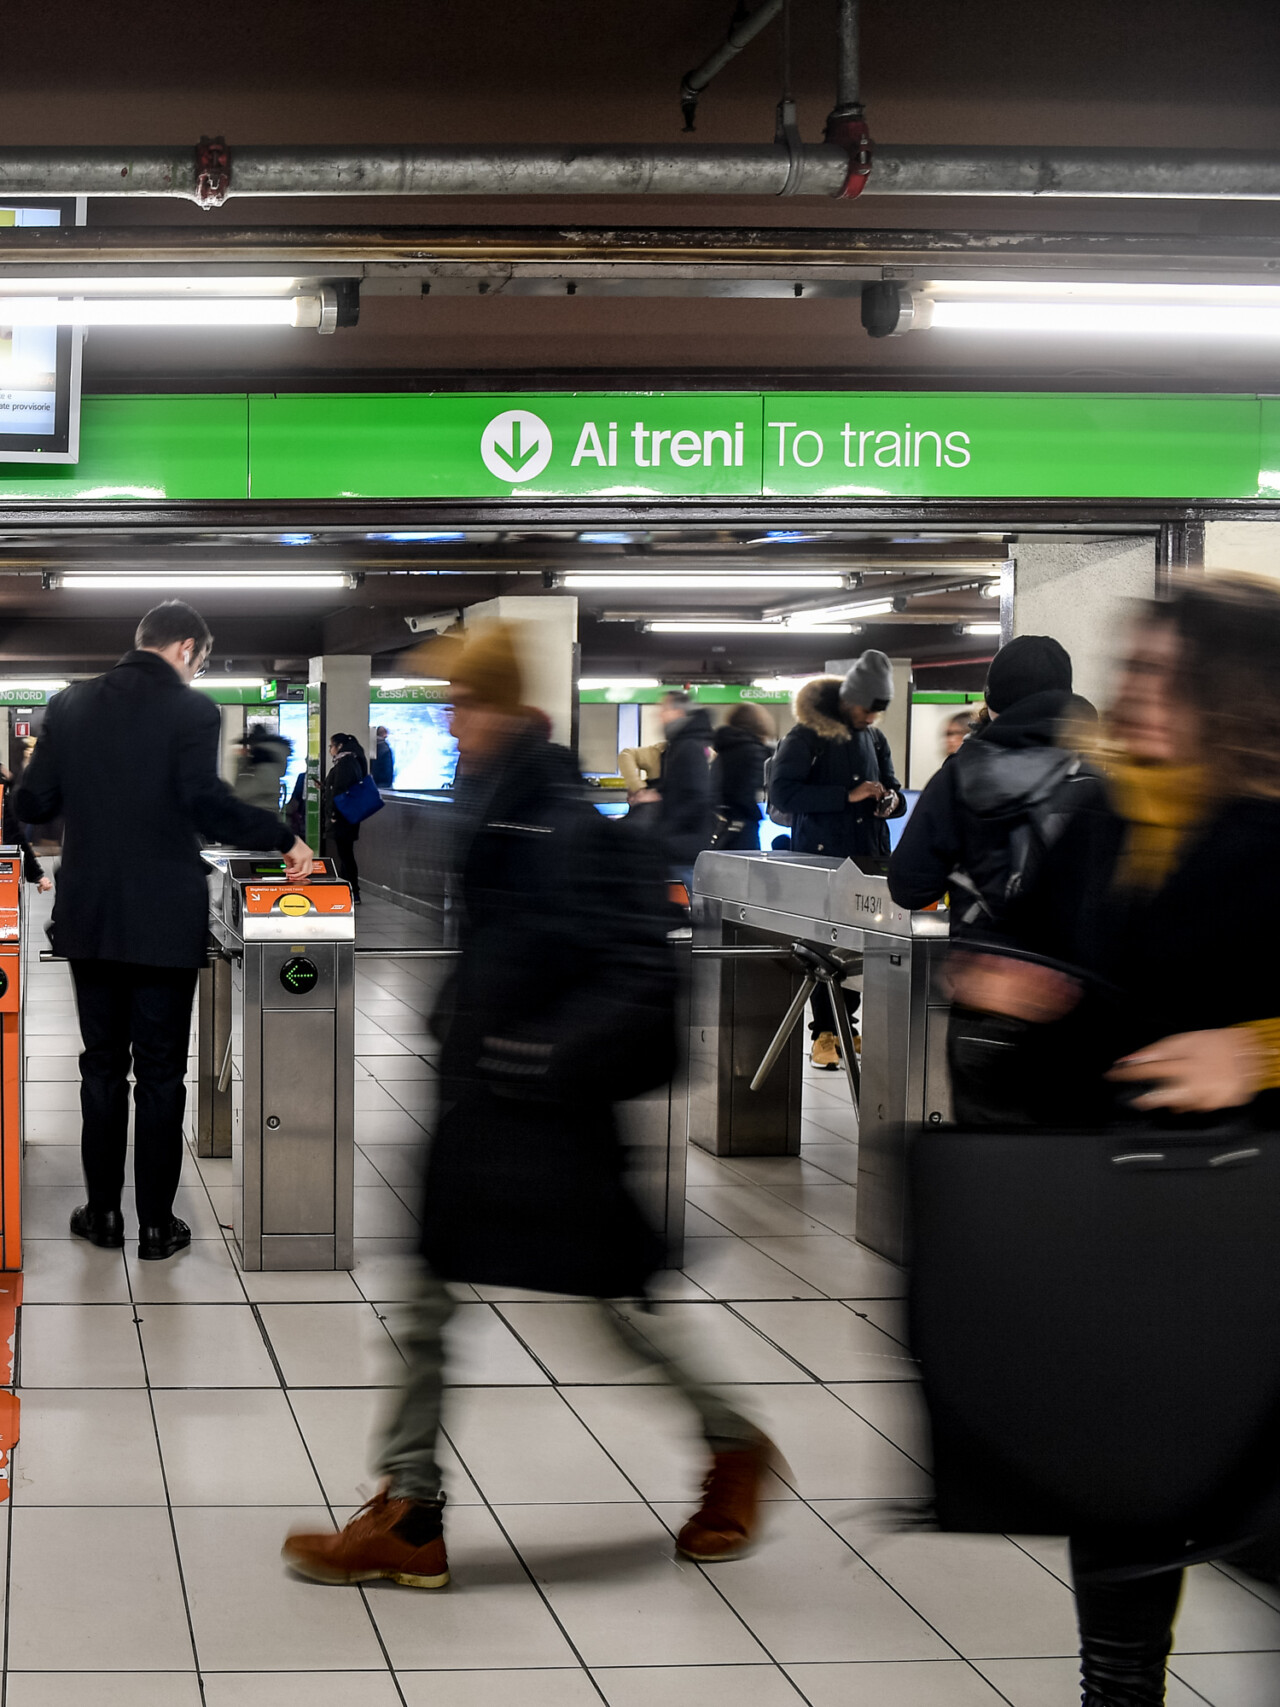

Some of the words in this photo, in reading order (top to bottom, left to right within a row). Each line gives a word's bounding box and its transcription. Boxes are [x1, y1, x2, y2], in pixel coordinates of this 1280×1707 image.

[12, 402, 51, 411] provvisorie
[570, 421, 618, 467] Ai
[631, 421, 744, 467] treni
[767, 421, 824, 468] To
[840, 421, 971, 468] trains
[16, 691, 42, 700] NORD
[740, 689, 781, 699] GESSATE
